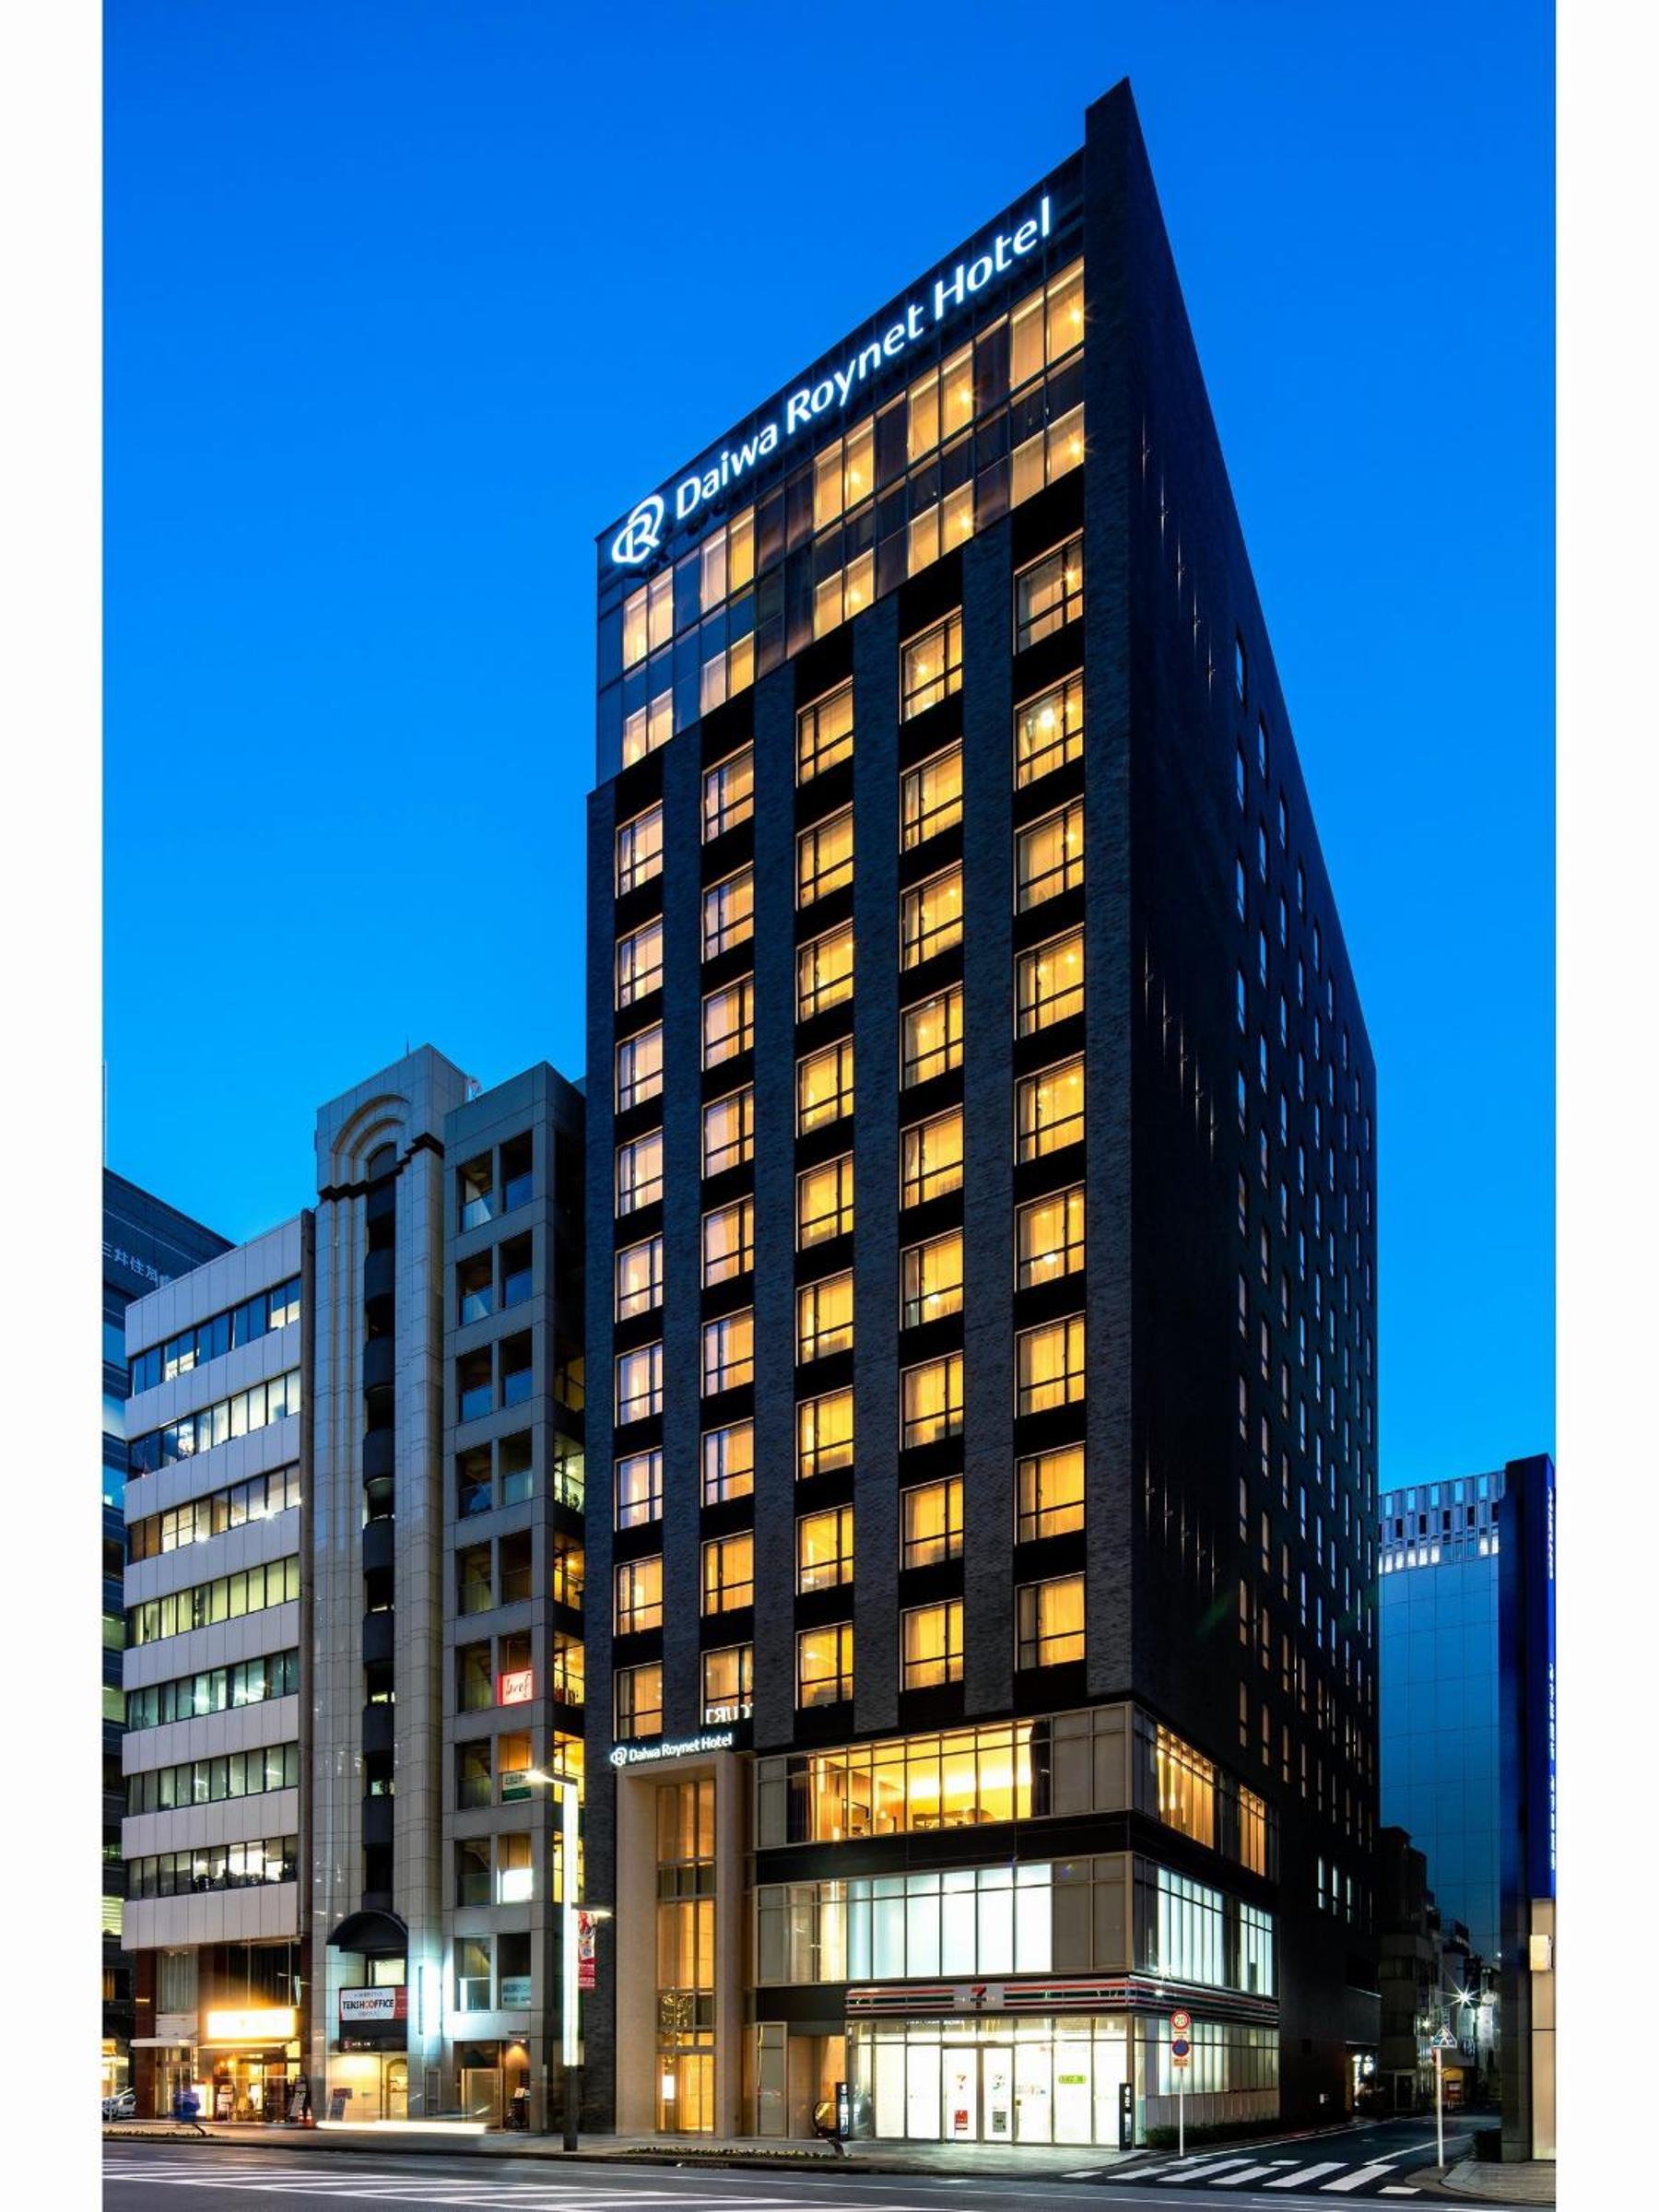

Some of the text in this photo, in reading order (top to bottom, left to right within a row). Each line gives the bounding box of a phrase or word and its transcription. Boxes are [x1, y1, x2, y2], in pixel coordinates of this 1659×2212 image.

[675, 424, 779, 520] Daiwa
[786, 303, 924, 434] Roynet
[934, 195, 1050, 321] Hotel
[629, 1747, 661, 1761] Daiwa
[661, 1739, 700, 1757] Roynet
[701, 1733, 733, 1749] Hotel
